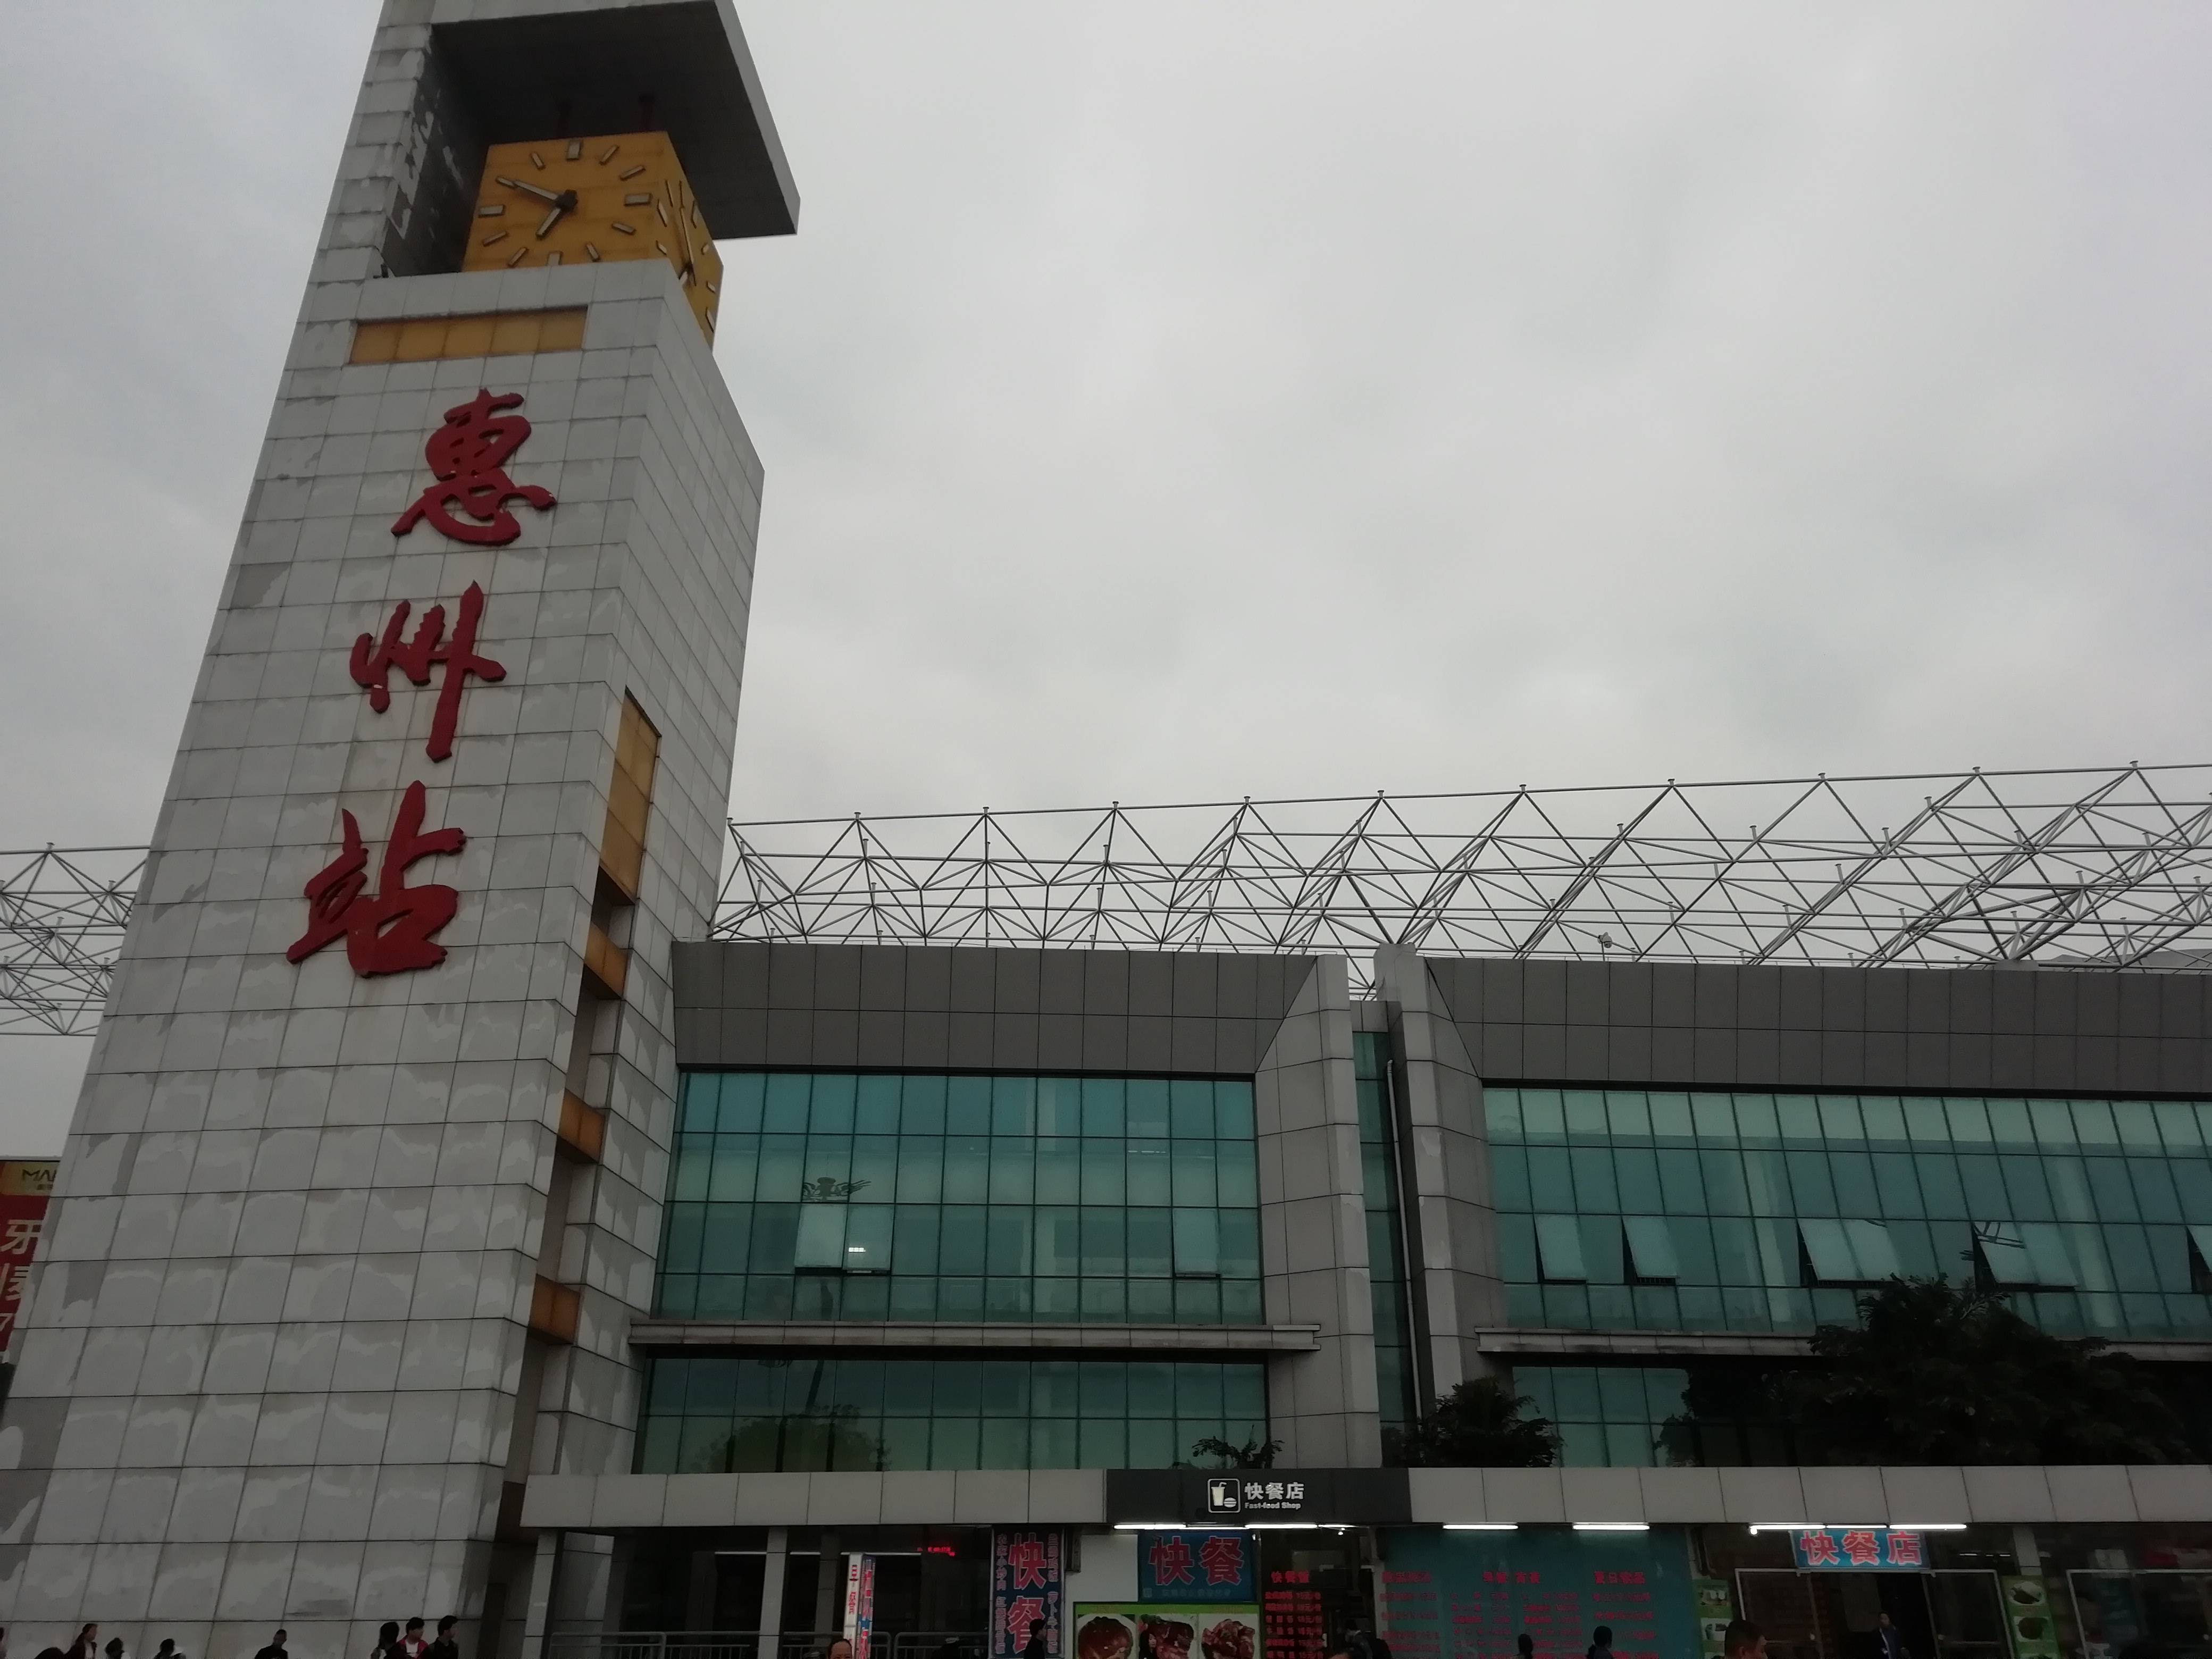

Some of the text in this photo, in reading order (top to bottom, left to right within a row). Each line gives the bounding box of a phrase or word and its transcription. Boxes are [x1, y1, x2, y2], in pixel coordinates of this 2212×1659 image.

[286, 388, 557, 978] 惠州站
[1244, 1482, 1304, 1500] 快餐店
[1148, 1535, 1245, 1586] 快餐
[1799, 1530, 1923, 1566] 快餐店
[1007, 1532, 1047, 1655] 快餐
